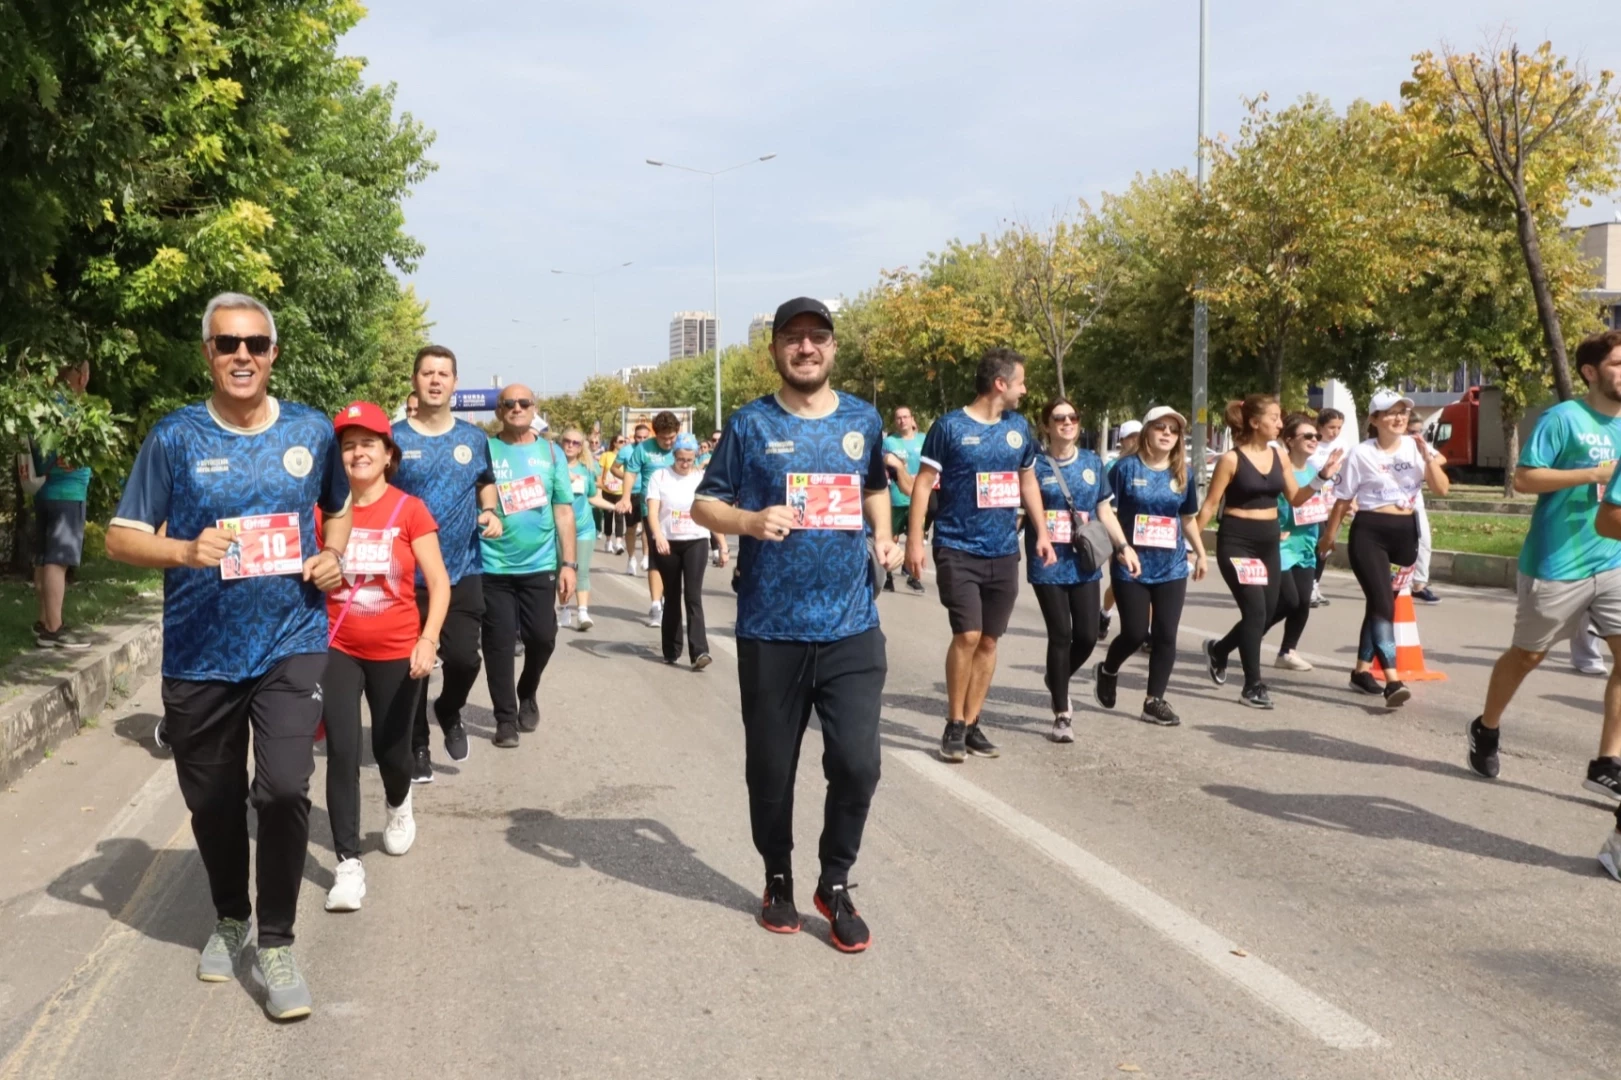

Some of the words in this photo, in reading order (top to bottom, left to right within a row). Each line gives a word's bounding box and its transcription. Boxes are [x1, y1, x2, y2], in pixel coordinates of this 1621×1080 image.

[1577, 432, 1612, 446] YOLA
[828, 489, 841, 513] 2
[258, 532, 287, 559] 10
